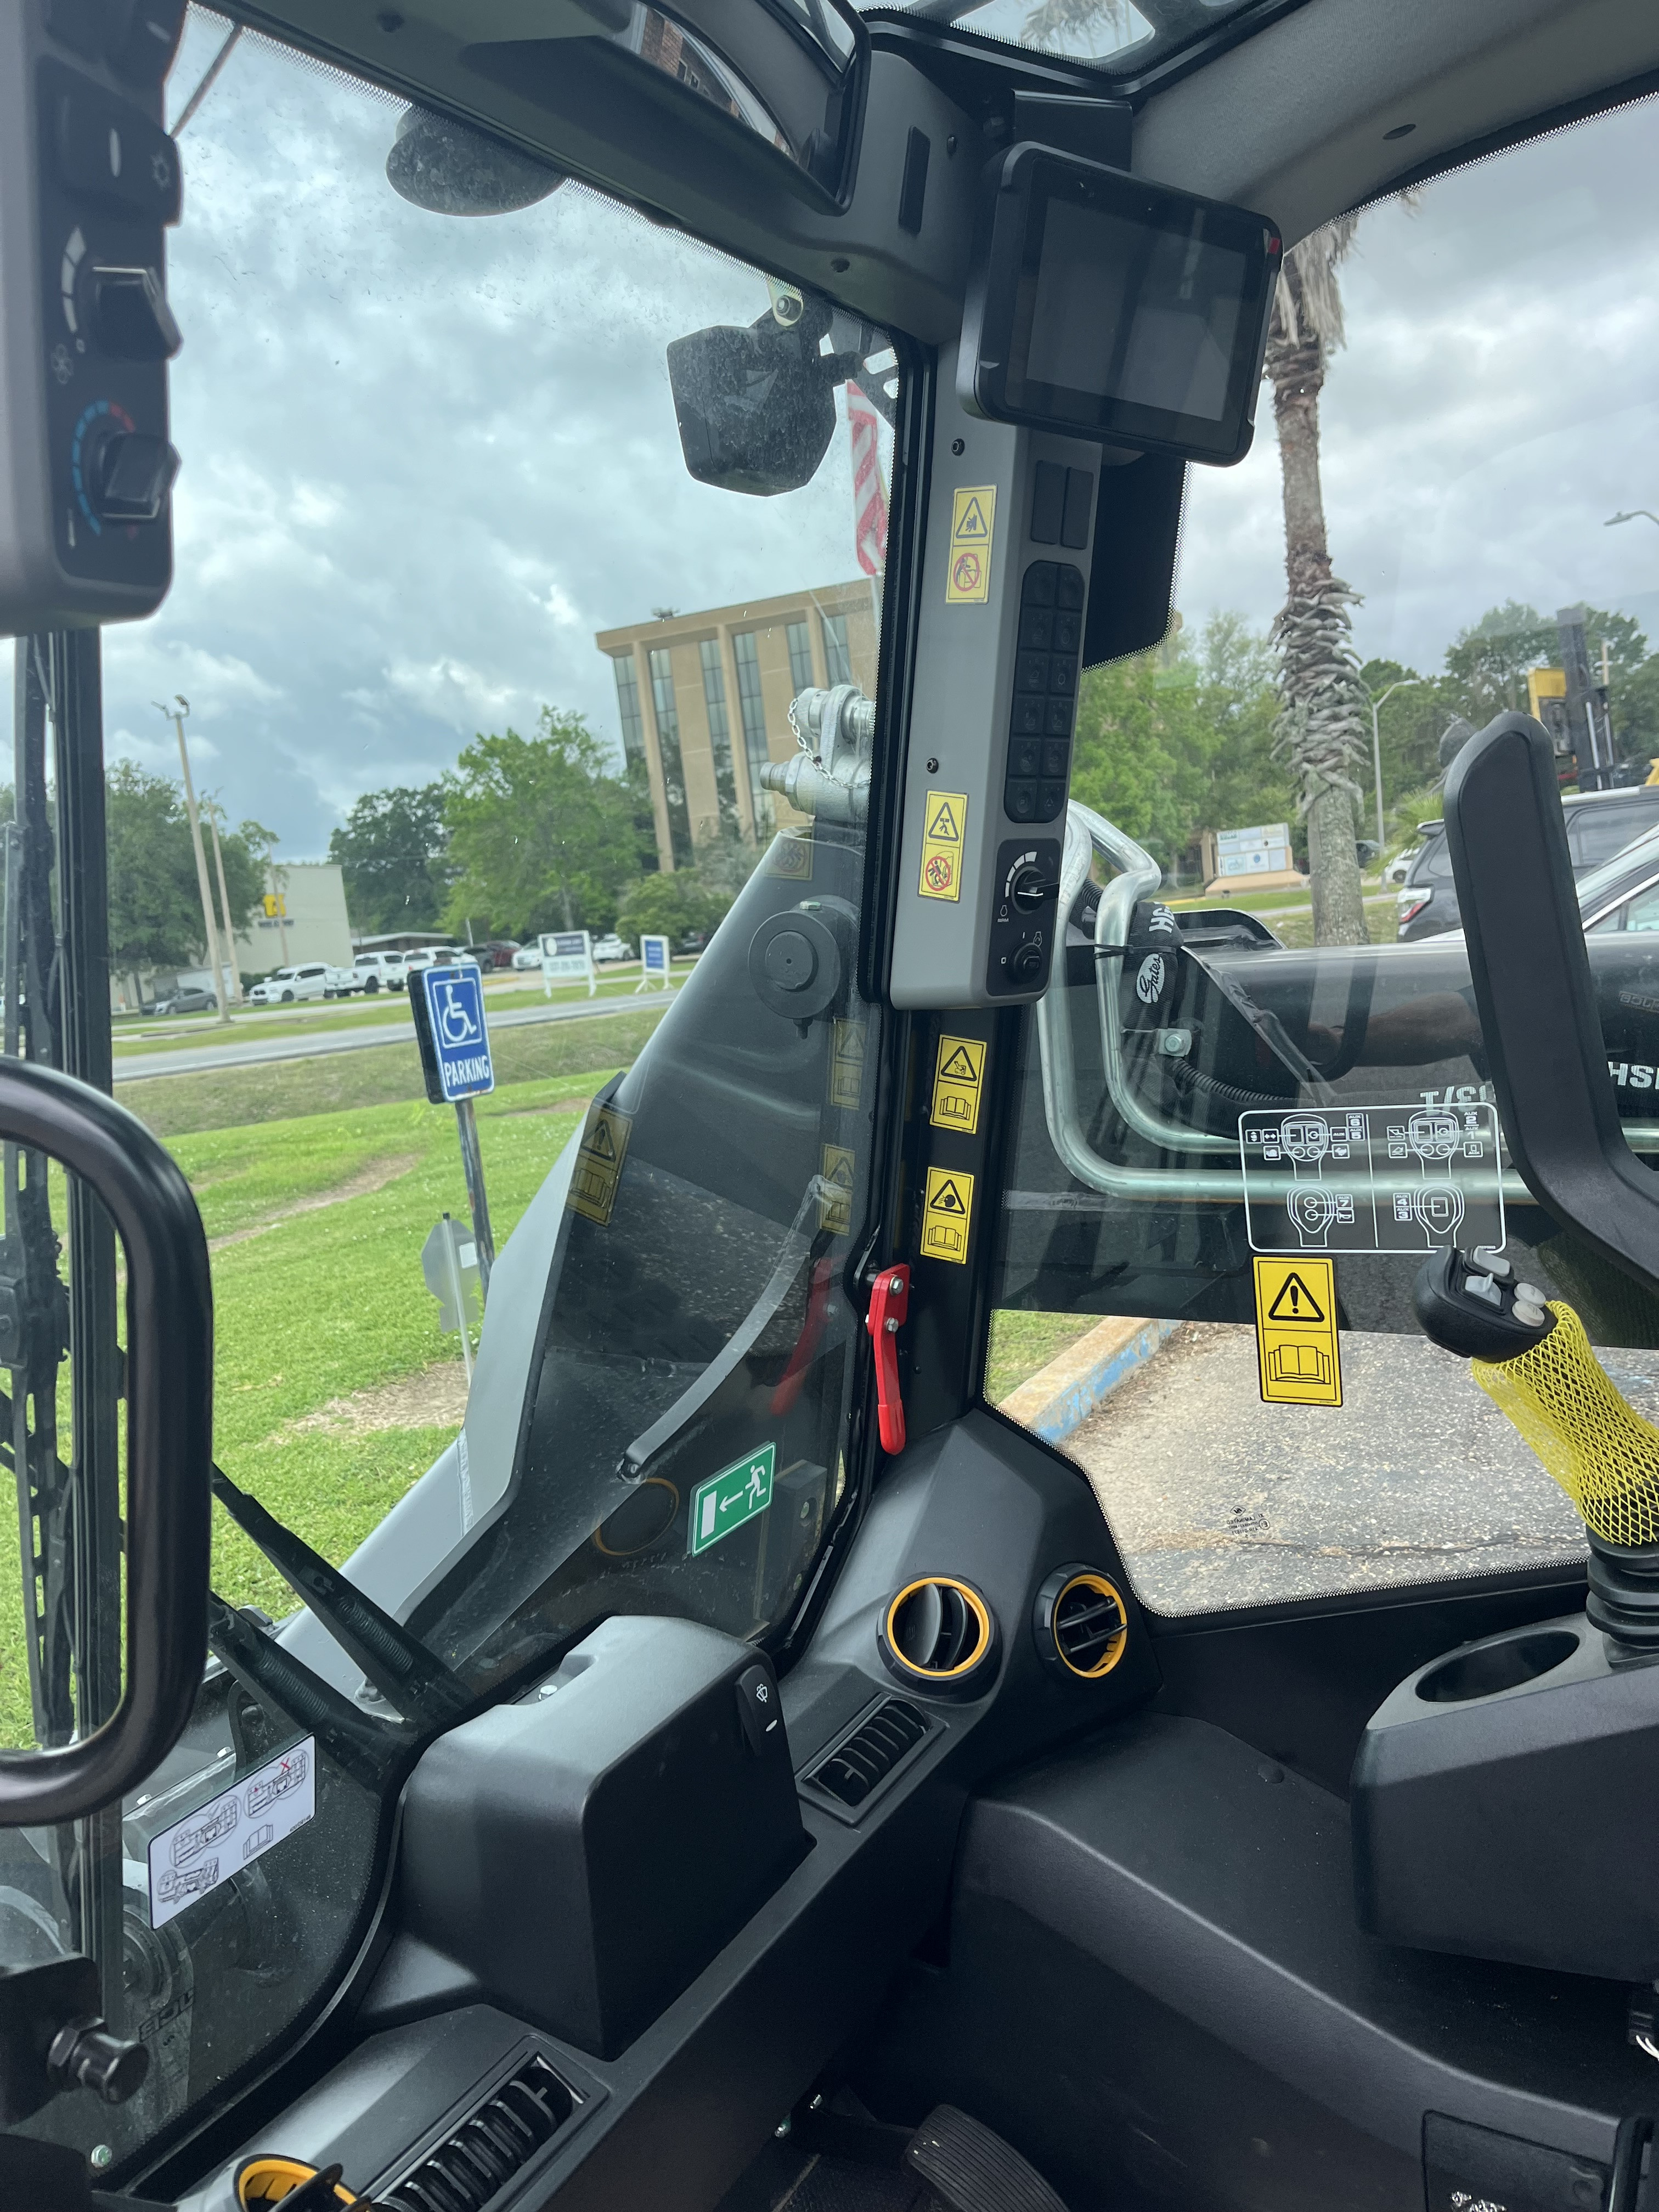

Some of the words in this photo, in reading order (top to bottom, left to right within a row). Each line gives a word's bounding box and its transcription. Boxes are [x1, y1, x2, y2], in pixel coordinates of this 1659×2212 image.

[1139, 955, 1163, 1002] Gates
[443, 1054, 490, 1087] PARKING
[1465, 1115, 1477, 1125] 2
[1466, 1131, 1475, 1140] 1
